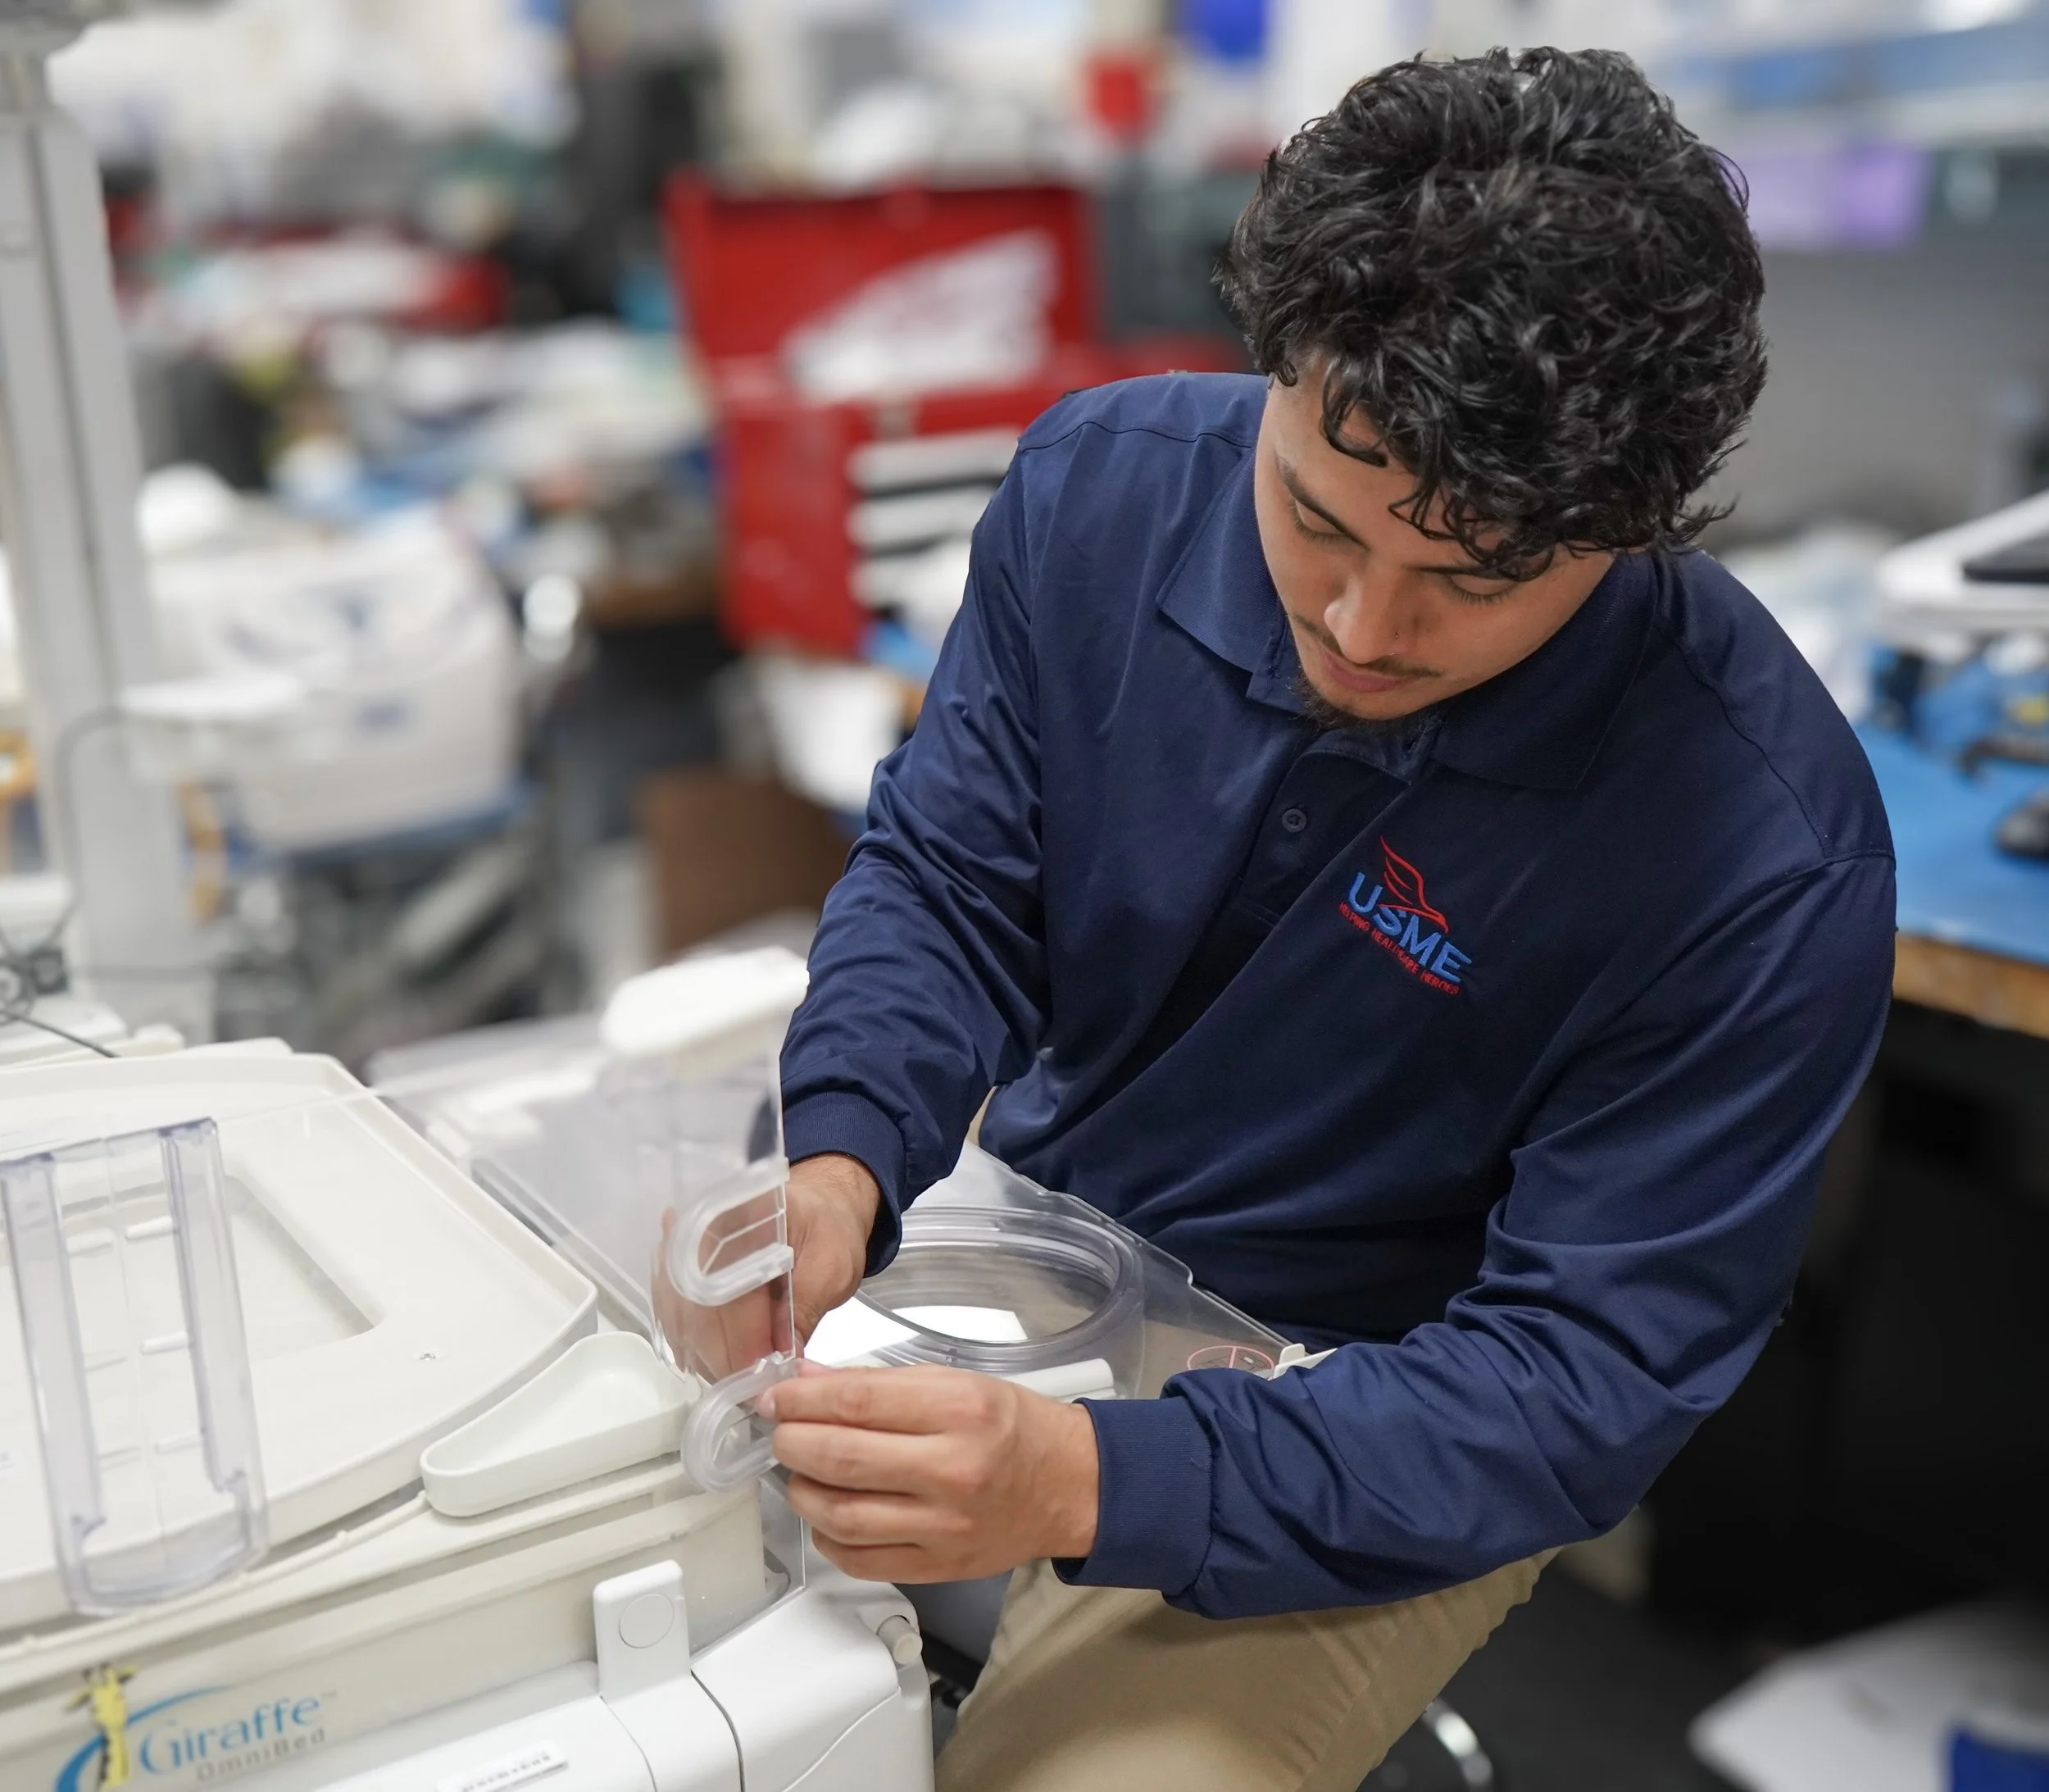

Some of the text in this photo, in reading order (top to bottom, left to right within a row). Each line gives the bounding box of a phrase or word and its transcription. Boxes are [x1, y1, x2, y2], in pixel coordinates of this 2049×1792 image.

[1338, 902, 1371, 932] HELPING
[1420, 970, 1461, 996] HEROES
[1348, 872, 1472, 983] USME
[139, 1696, 320, 1775] Giraffe
[197, 1727, 325, 1782] OmniBed
